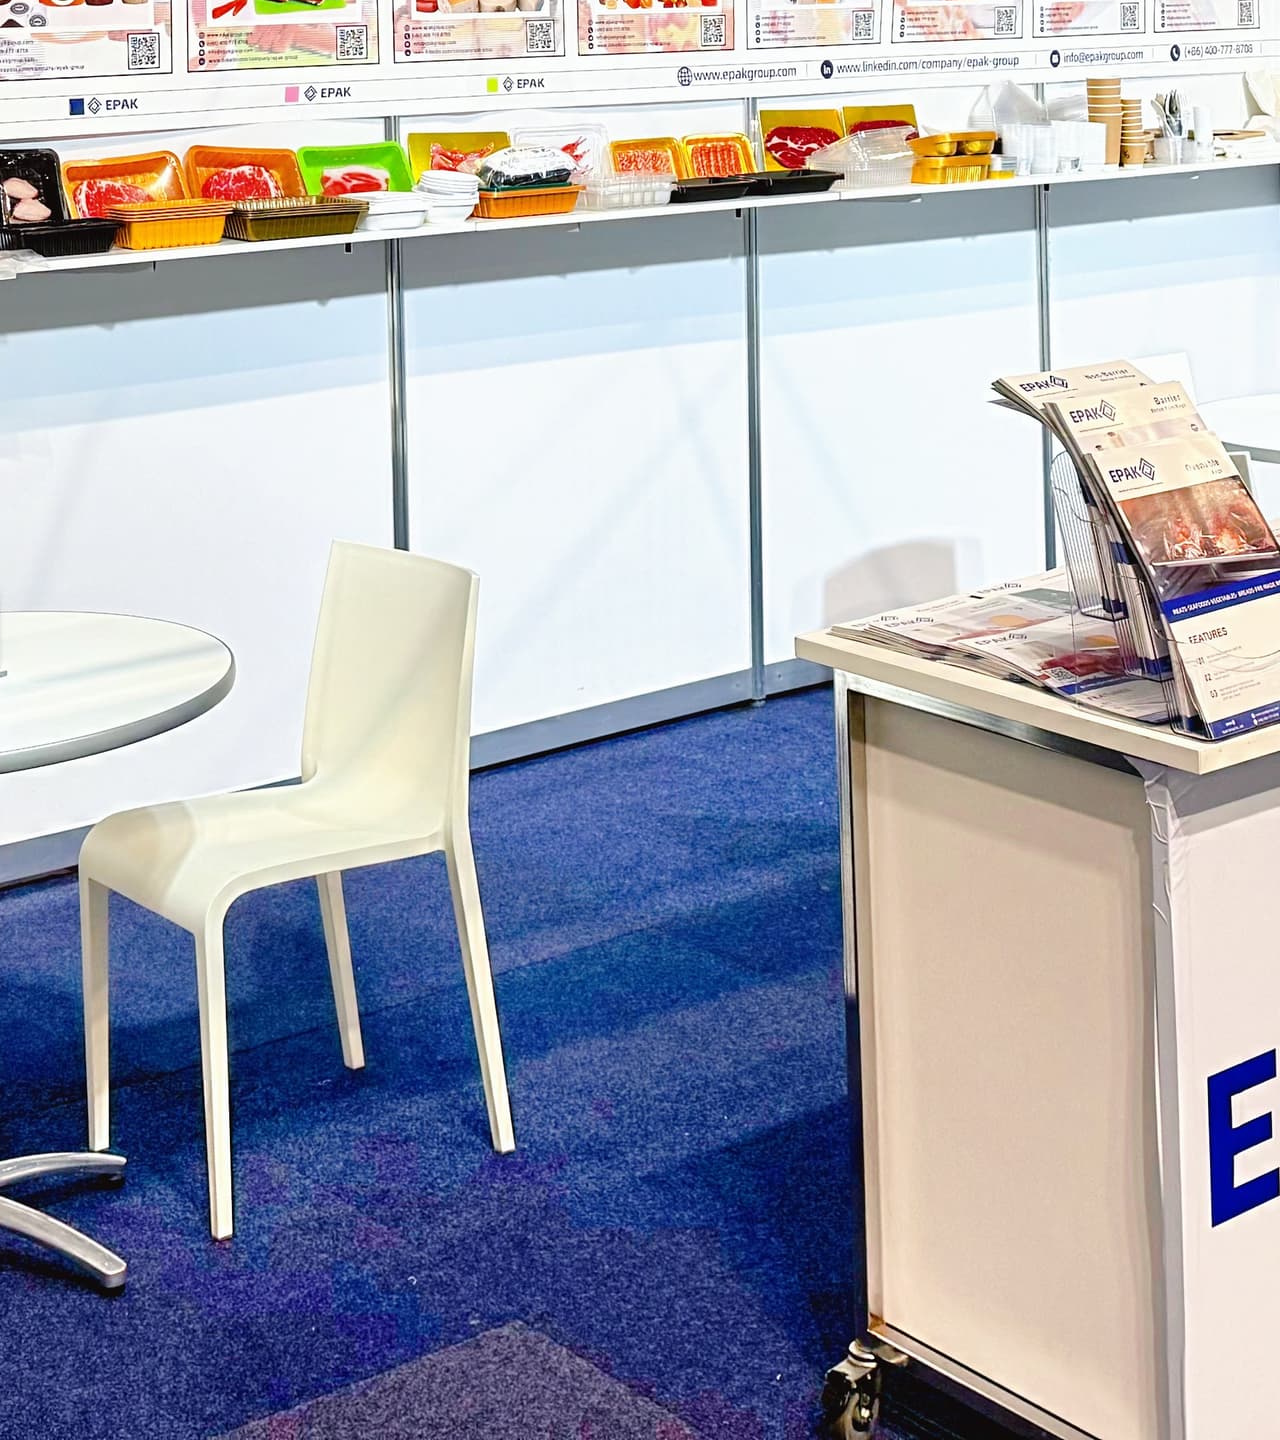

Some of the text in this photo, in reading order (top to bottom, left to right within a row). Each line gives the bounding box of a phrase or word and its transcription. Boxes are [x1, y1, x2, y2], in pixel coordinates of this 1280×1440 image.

[837, 54, 1019, 73] www.linkedin.com/company/epak-group
[1063, 49, 1144, 63] info@epakgroup.com
[694, 66, 796, 82] www.epakgroup.com
[1070, 405, 1101, 423] EPAK
[1109, 465, 1141, 484] EPAK
[1188, 626, 1228, 646] FEATURES
